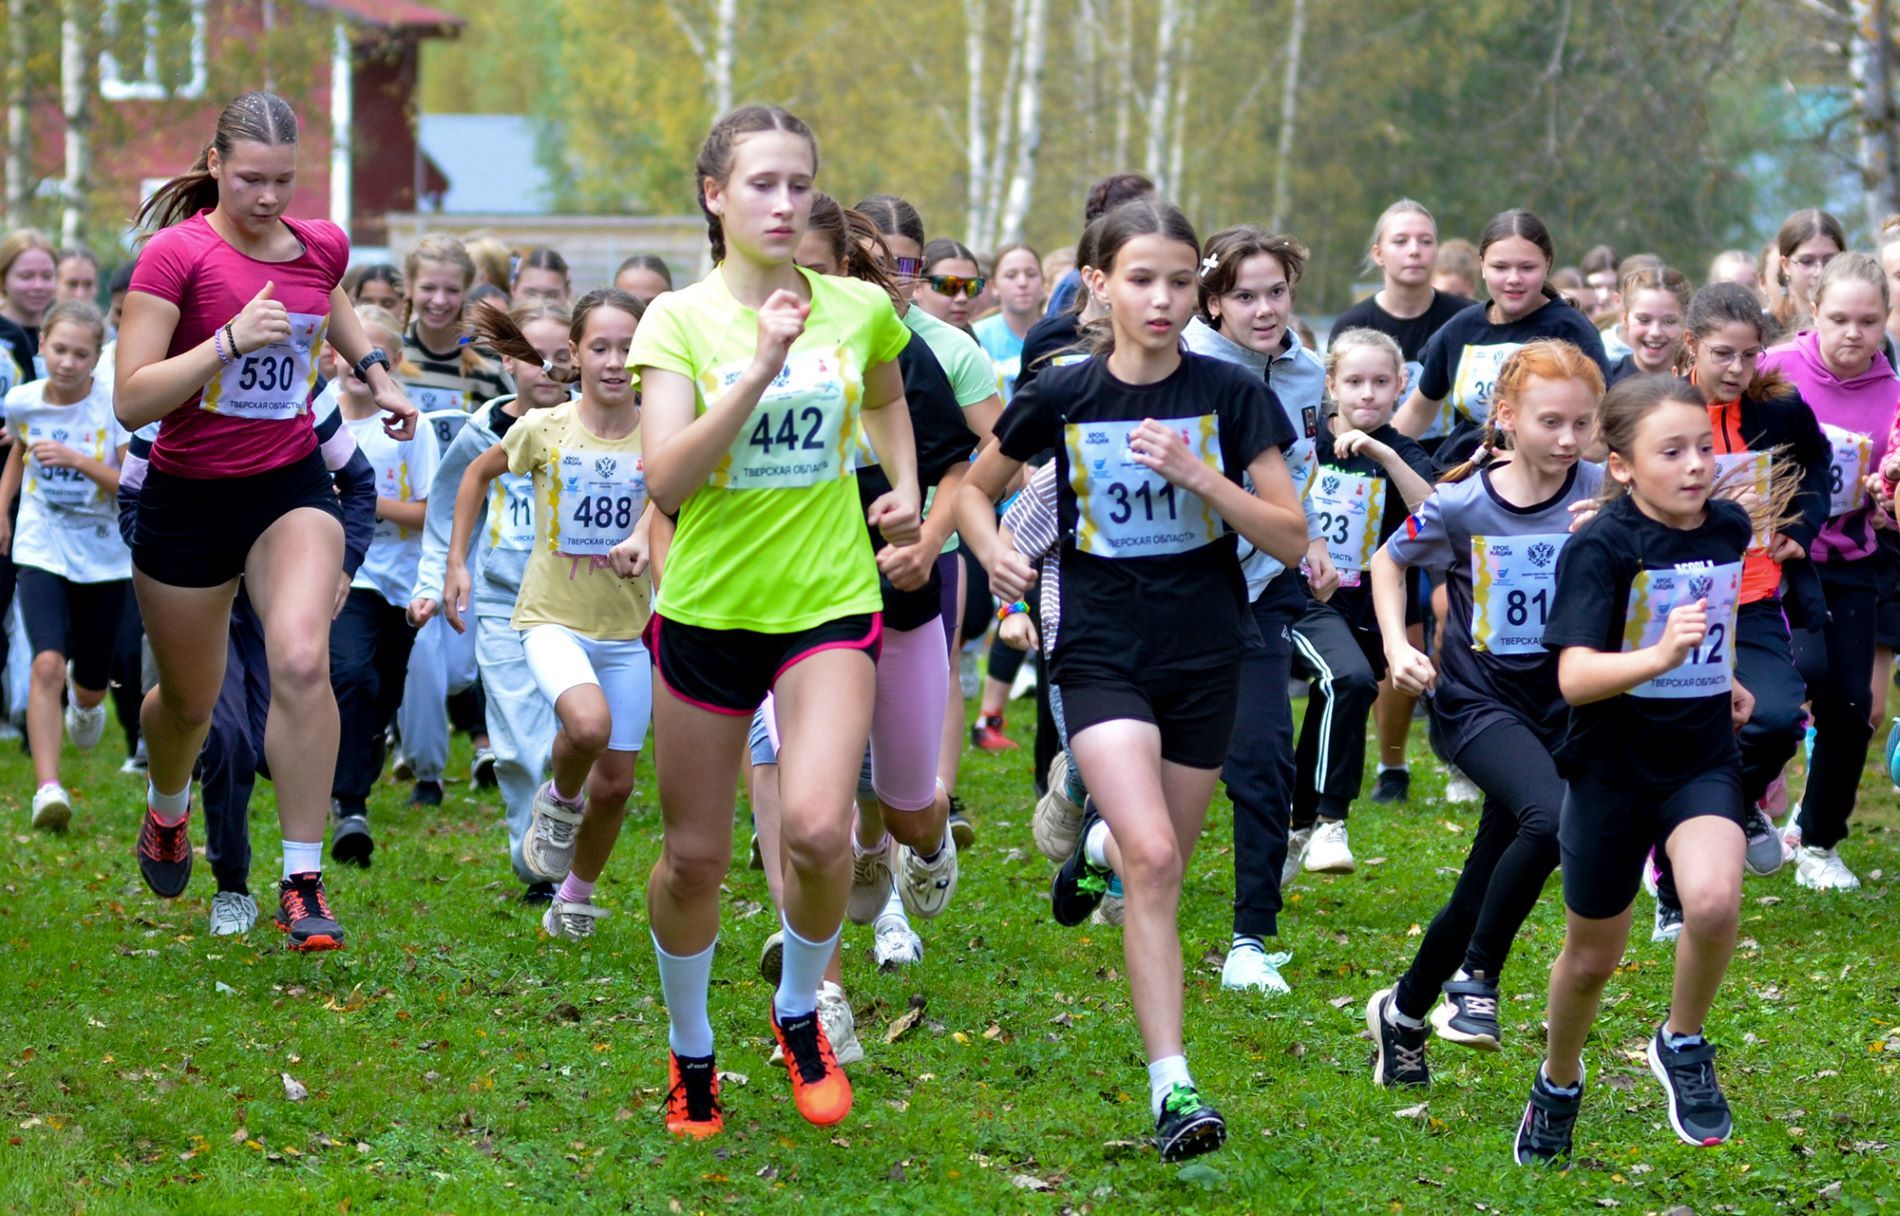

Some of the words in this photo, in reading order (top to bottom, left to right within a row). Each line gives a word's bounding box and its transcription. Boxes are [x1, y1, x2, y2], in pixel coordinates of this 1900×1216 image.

[238, 356, 294, 391] 530
[229, 400, 268, 410] ТВЕРСКАЯ
[749, 406, 824, 454] 442
[743, 465, 792, 477] ТВЕРСКАЯ
[573, 495, 632, 529] 488
[1107, 480, 1177, 525] 311
[567, 538, 604, 546] ТВЕРСКАЯ
[1153, 531, 1196, 545] ОБЛАСТЬ
[1507, 588, 1548, 627] 81
